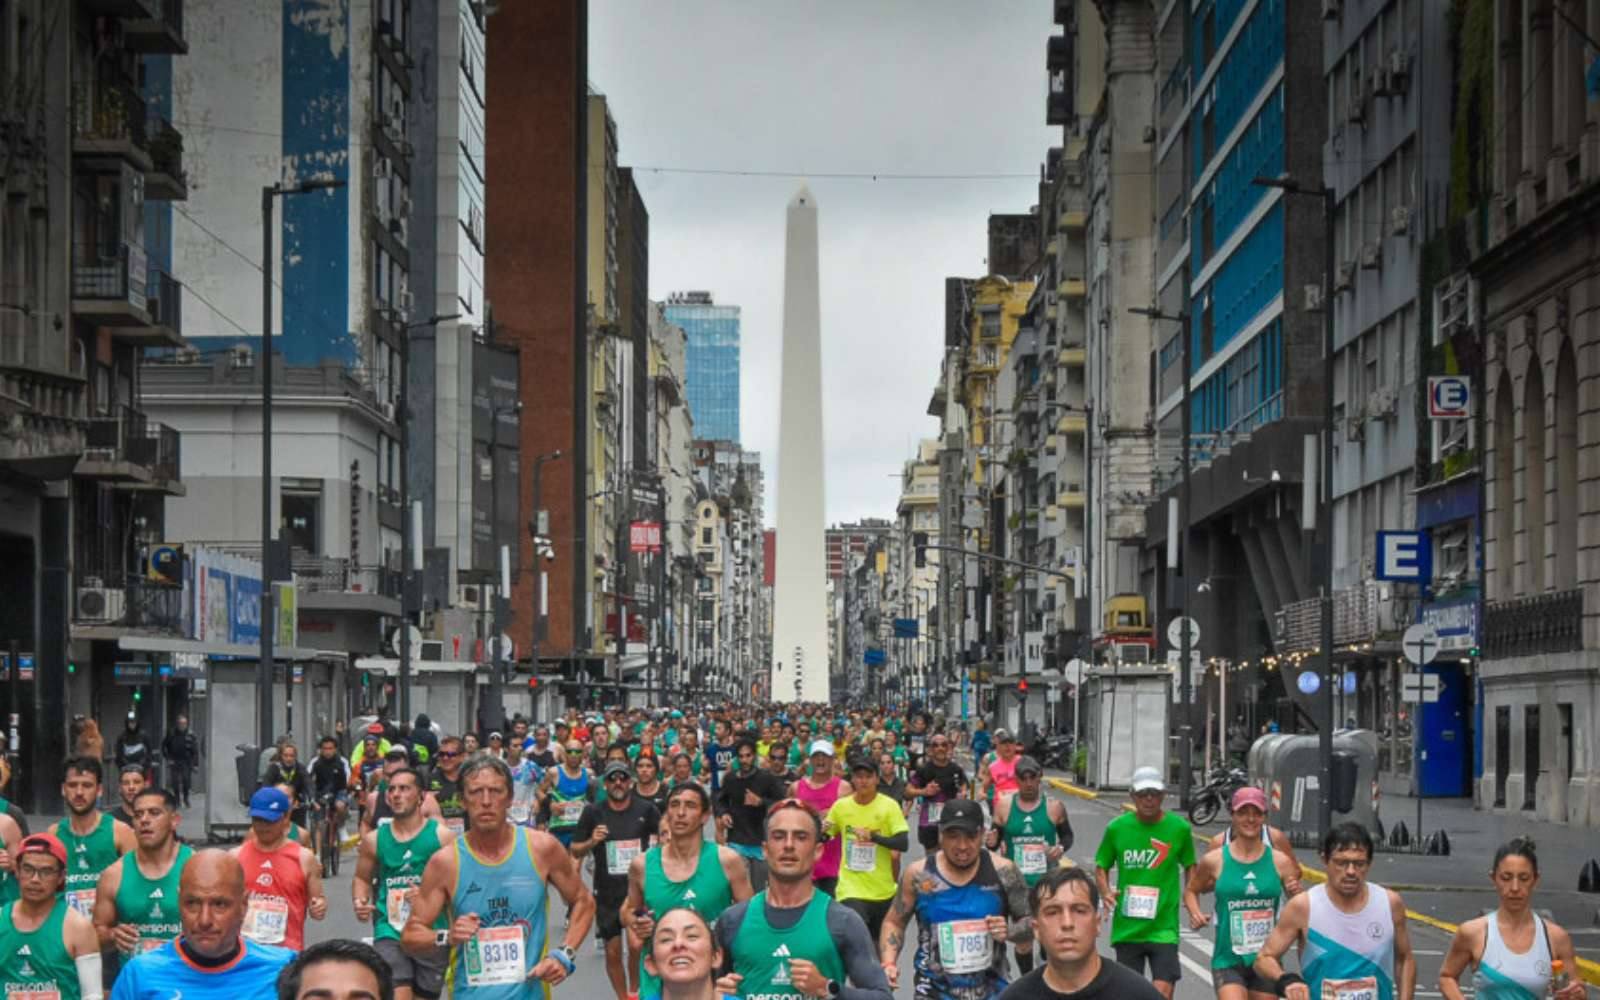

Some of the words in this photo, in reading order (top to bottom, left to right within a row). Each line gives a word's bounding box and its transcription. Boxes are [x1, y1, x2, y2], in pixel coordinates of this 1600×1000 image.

[1440, 383, 1463, 408] E
[1383, 534, 1418, 576] E
[1123, 849, 1156, 864] RM7
[488, 897, 509, 910] TEAM
[484, 943, 518, 963] 8318
